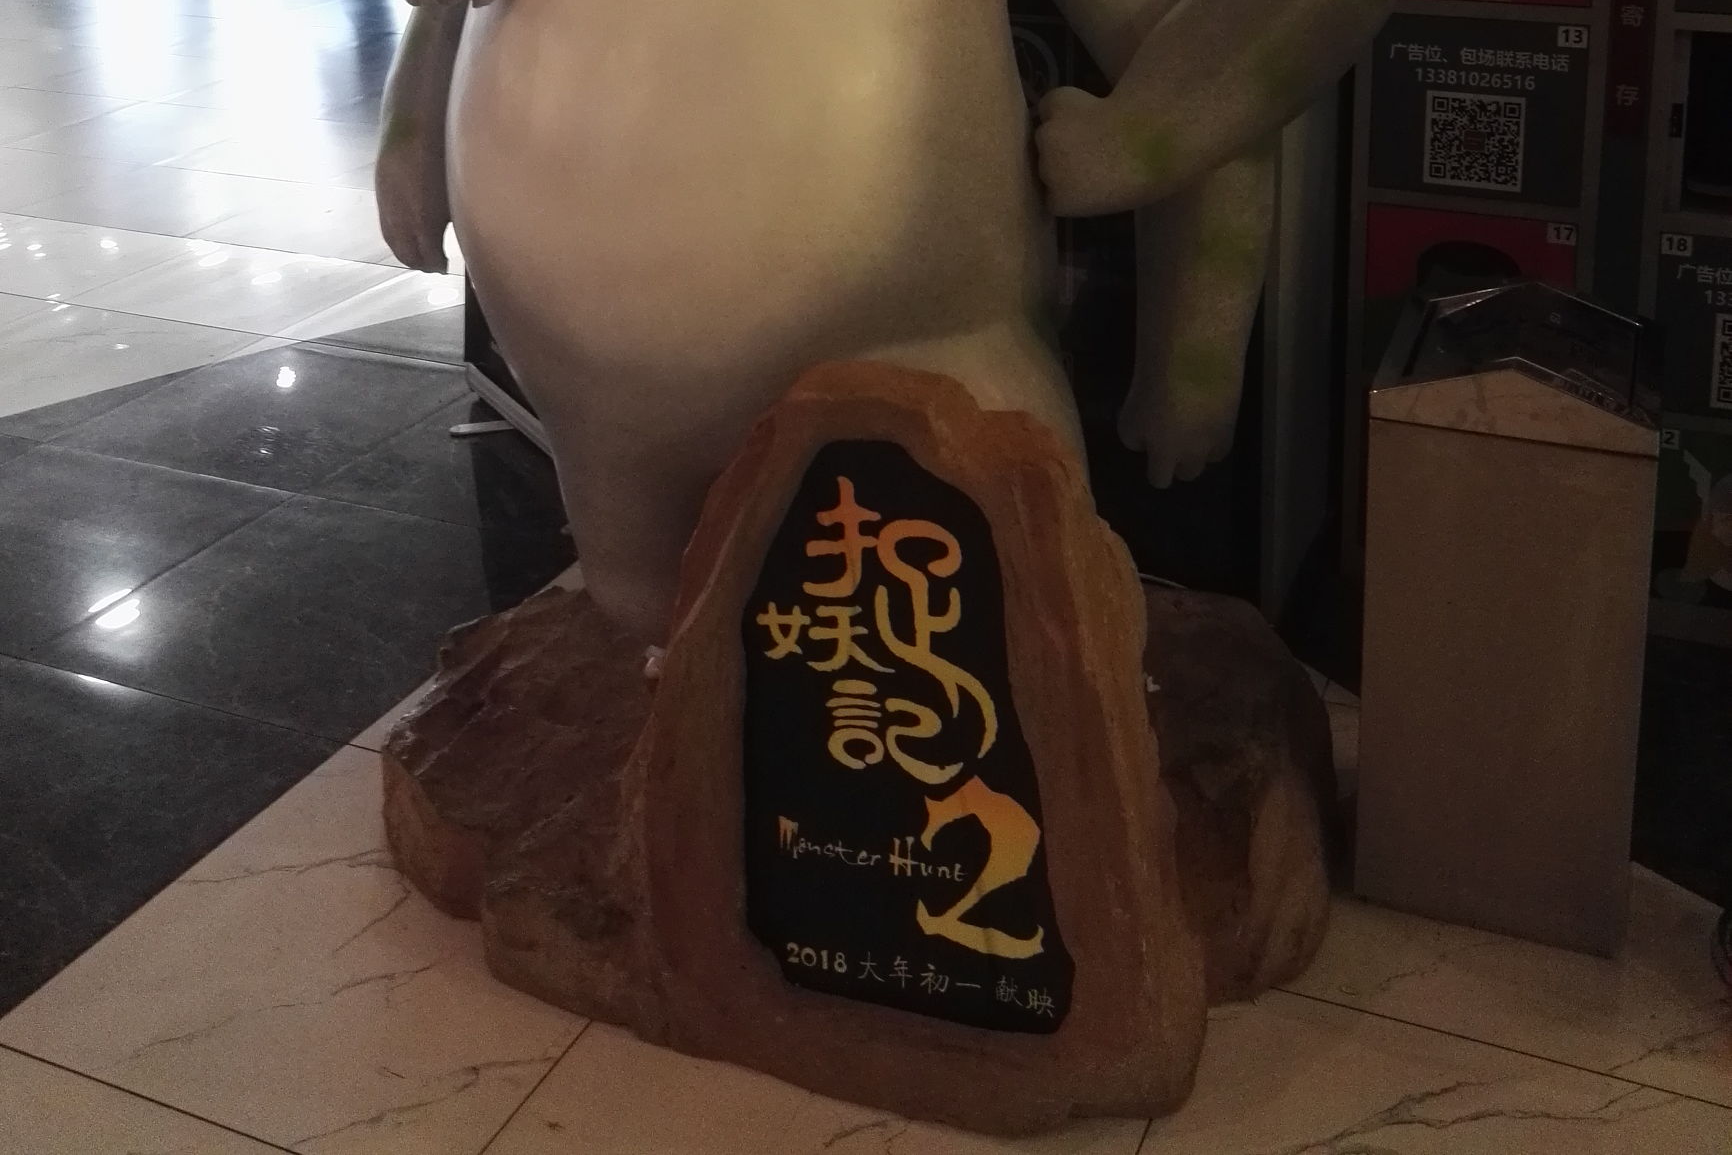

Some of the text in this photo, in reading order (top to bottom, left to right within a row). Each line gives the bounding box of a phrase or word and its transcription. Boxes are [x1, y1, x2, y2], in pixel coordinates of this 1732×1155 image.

[1562, 28, 1583, 45] 13
[1415, 67, 1536, 91] 13381026516
[1553, 226, 1574, 241] 17
[1665, 237, 1688, 252] 18
[888, 836, 968, 882] Hunt
[916, 774, 1045, 960] 2
[785, 942, 848, 974] 2018
